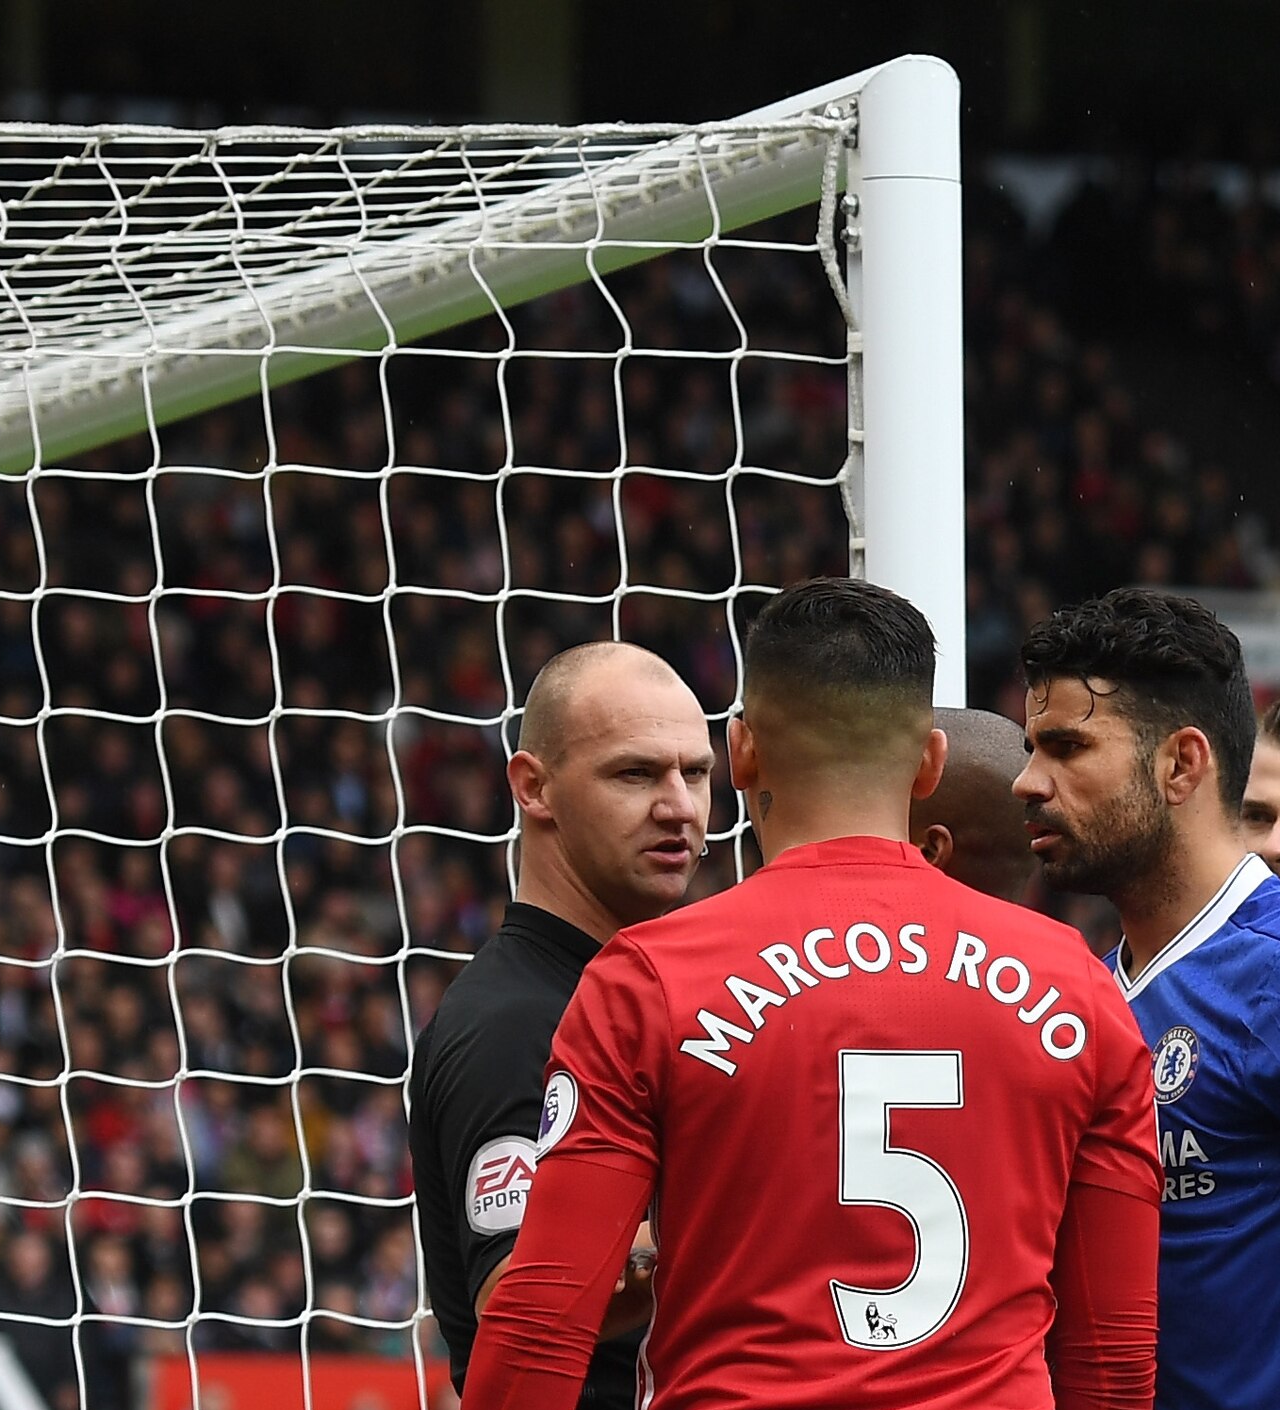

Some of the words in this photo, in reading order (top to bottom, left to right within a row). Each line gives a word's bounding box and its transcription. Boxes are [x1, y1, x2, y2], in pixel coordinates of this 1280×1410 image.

[679, 922, 927, 1077] MARCOS
[945, 931, 1088, 1062] ROJO
[1162, 1029, 1195, 1047] CHELSEA
[475, 1155, 535, 1199] EA
[829, 1050, 969, 1351] 5
